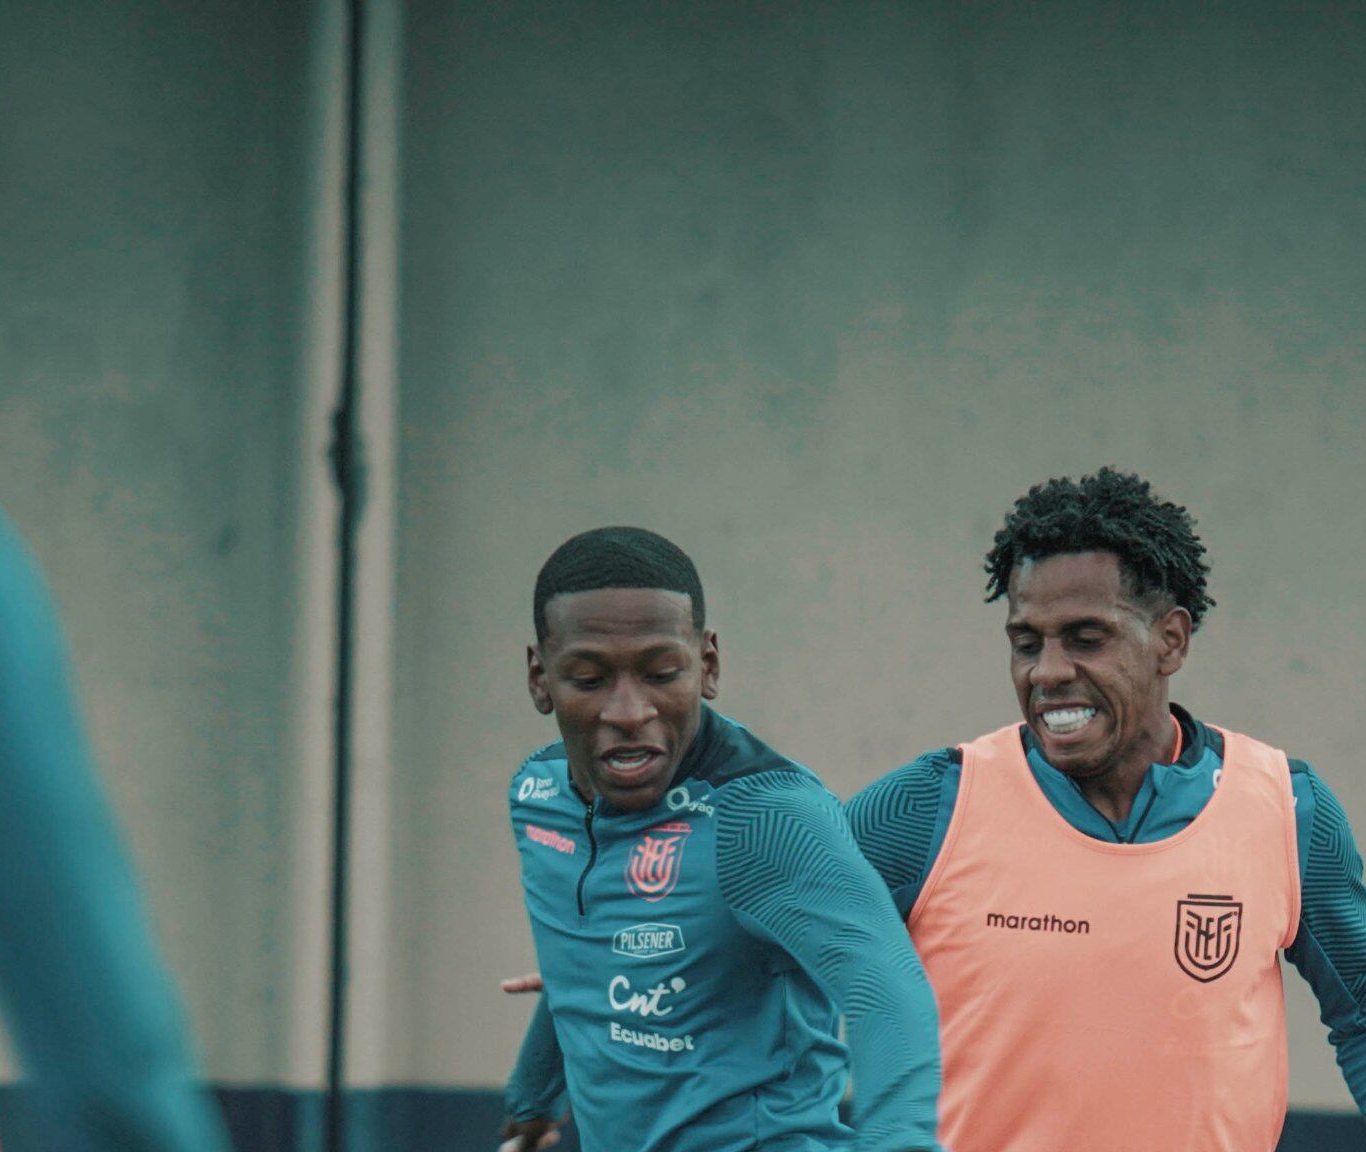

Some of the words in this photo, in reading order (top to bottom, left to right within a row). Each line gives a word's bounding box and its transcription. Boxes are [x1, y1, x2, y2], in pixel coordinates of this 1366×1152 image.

[986, 913, 1090, 934] marathon
[620, 930, 674, 949] PILSENER
[609, 975, 673, 1016] Cnt
[610, 1021, 694, 1052] Ecuabet
